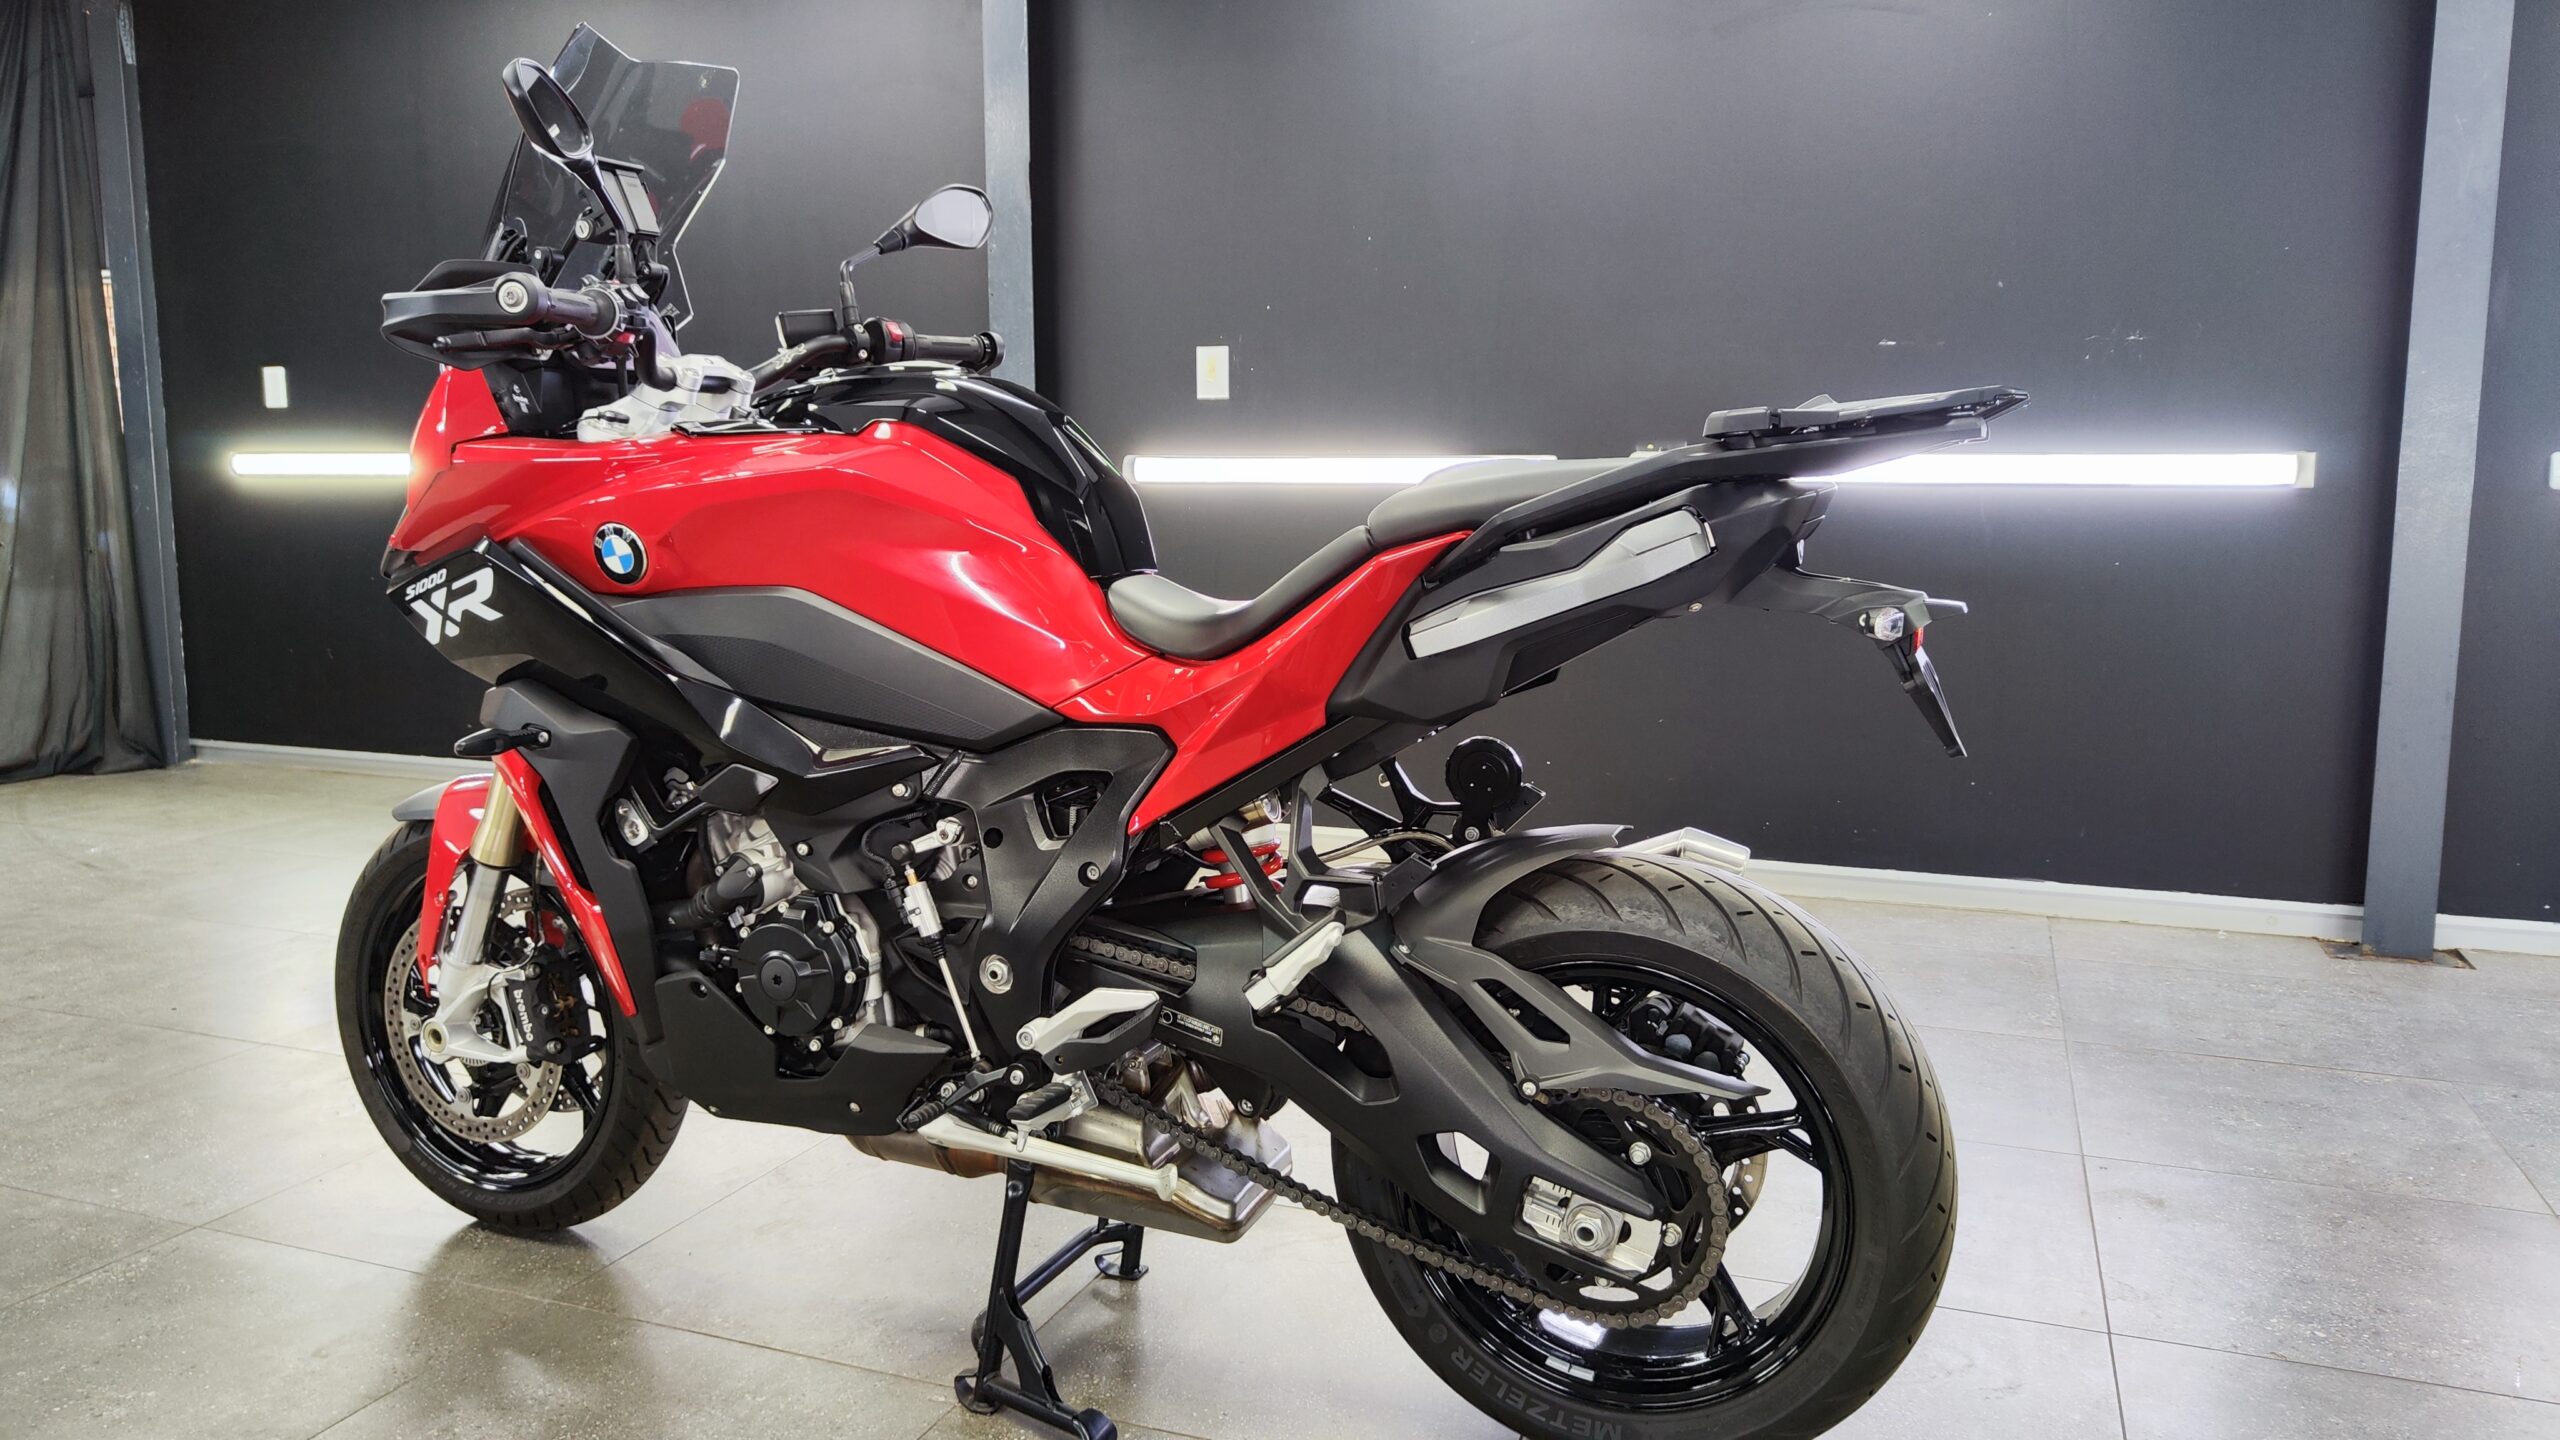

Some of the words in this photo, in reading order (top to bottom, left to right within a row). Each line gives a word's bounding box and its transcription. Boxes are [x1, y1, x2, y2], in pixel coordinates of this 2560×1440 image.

[405, 568, 447, 600] S1000
[513, 989, 534, 1042] brembo
[1450, 1346, 1622, 1440] METZELER
